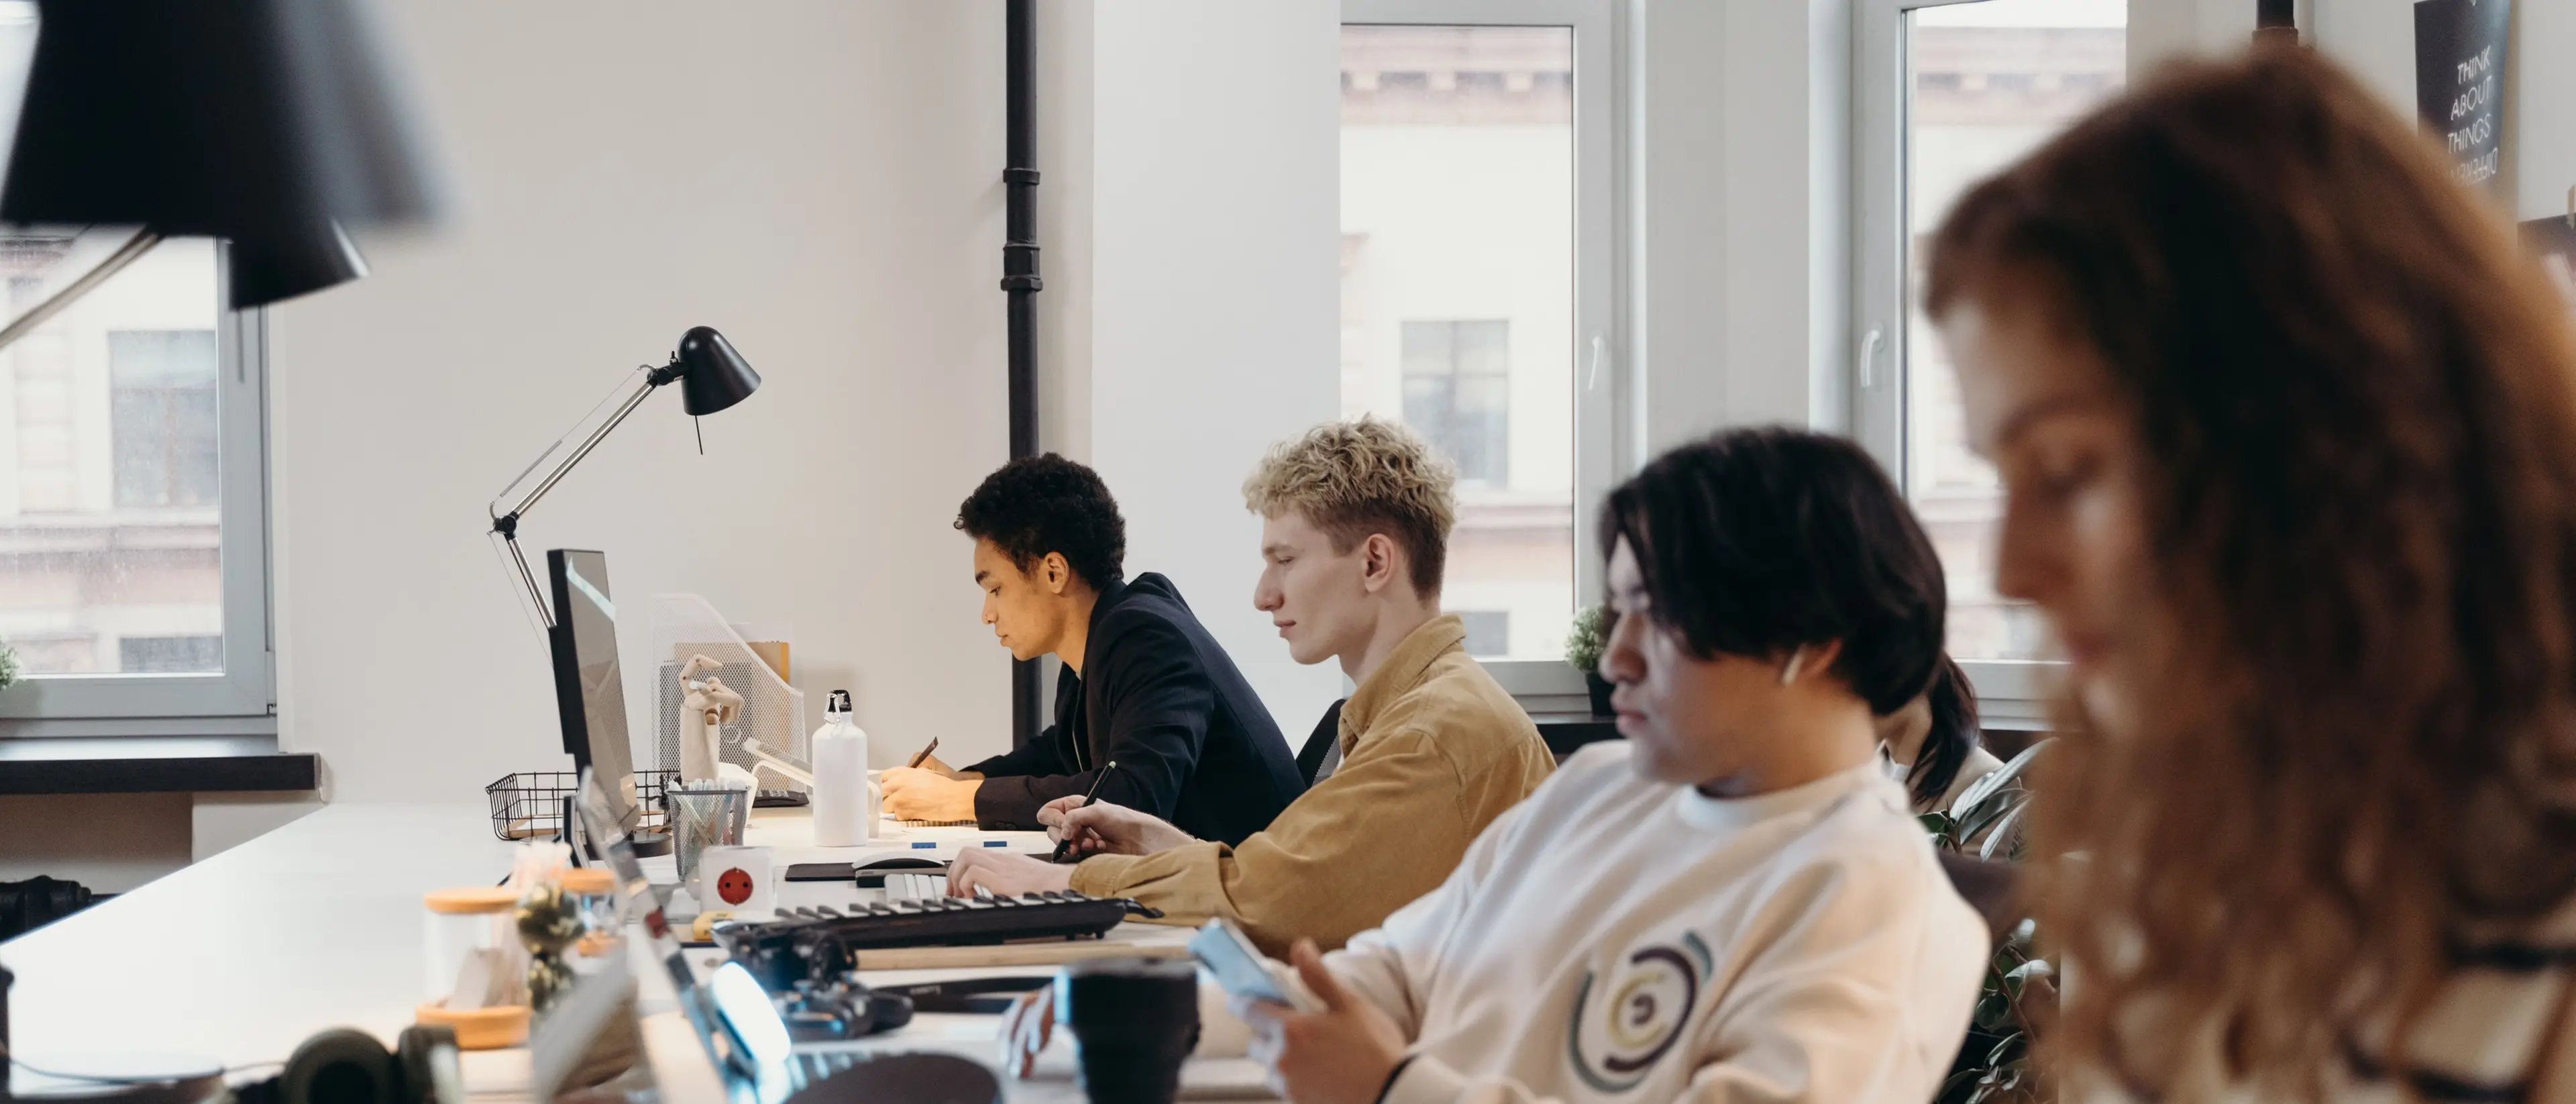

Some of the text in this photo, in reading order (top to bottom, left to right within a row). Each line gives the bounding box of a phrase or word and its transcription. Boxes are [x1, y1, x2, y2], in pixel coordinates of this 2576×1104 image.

[2457, 44, 2491, 85] THINK
[2451, 75, 2492, 121] ABOUT
[2447, 113, 2491, 154] THINGS
[2449, 147, 2498, 187] DIFFEREN
